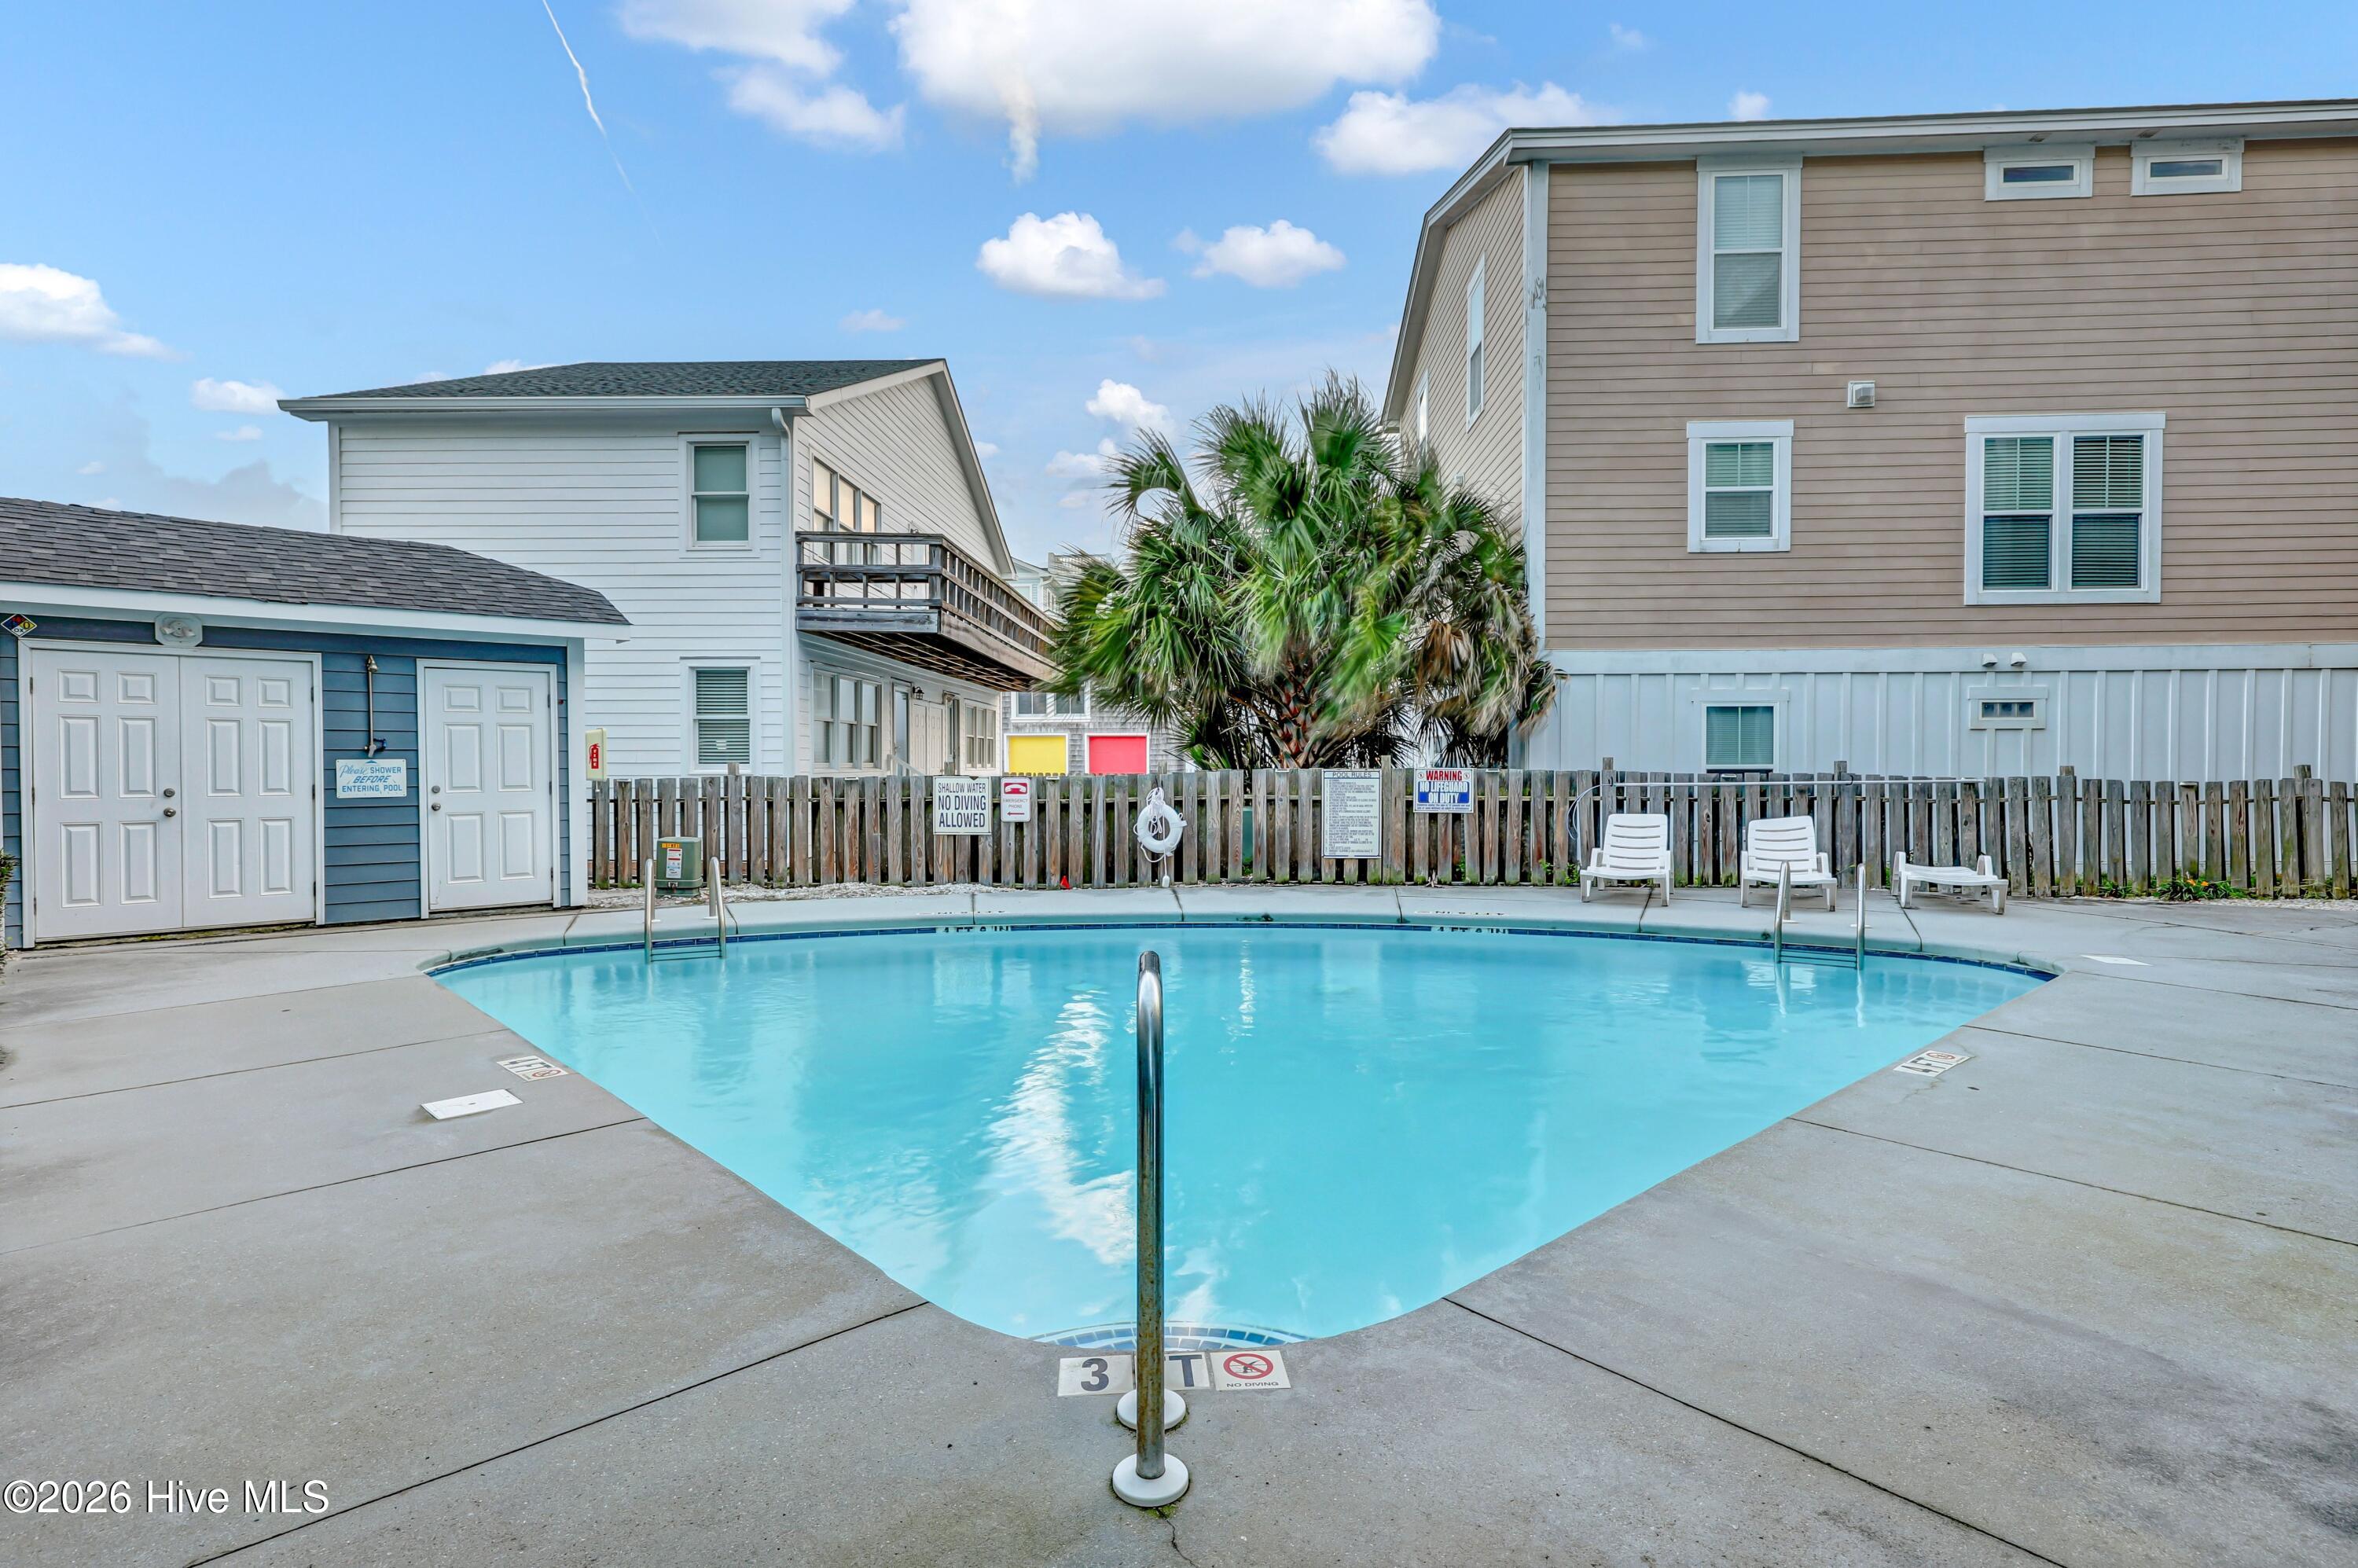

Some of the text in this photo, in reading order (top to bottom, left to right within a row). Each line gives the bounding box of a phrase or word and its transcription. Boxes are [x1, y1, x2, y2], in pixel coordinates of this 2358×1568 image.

[1426, 770, 1463, 780] WARNING
[938, 782, 986, 793] SHALLOW WATER
[1420, 781, 1468, 792] NO LIFEGUARD
[938, 795, 986, 810] NO DIVING
[1428, 792, 1460, 803] ON DUTY
[938, 813, 986, 828] ALLOWED
[1081, 1357, 1110, 1392] 3
